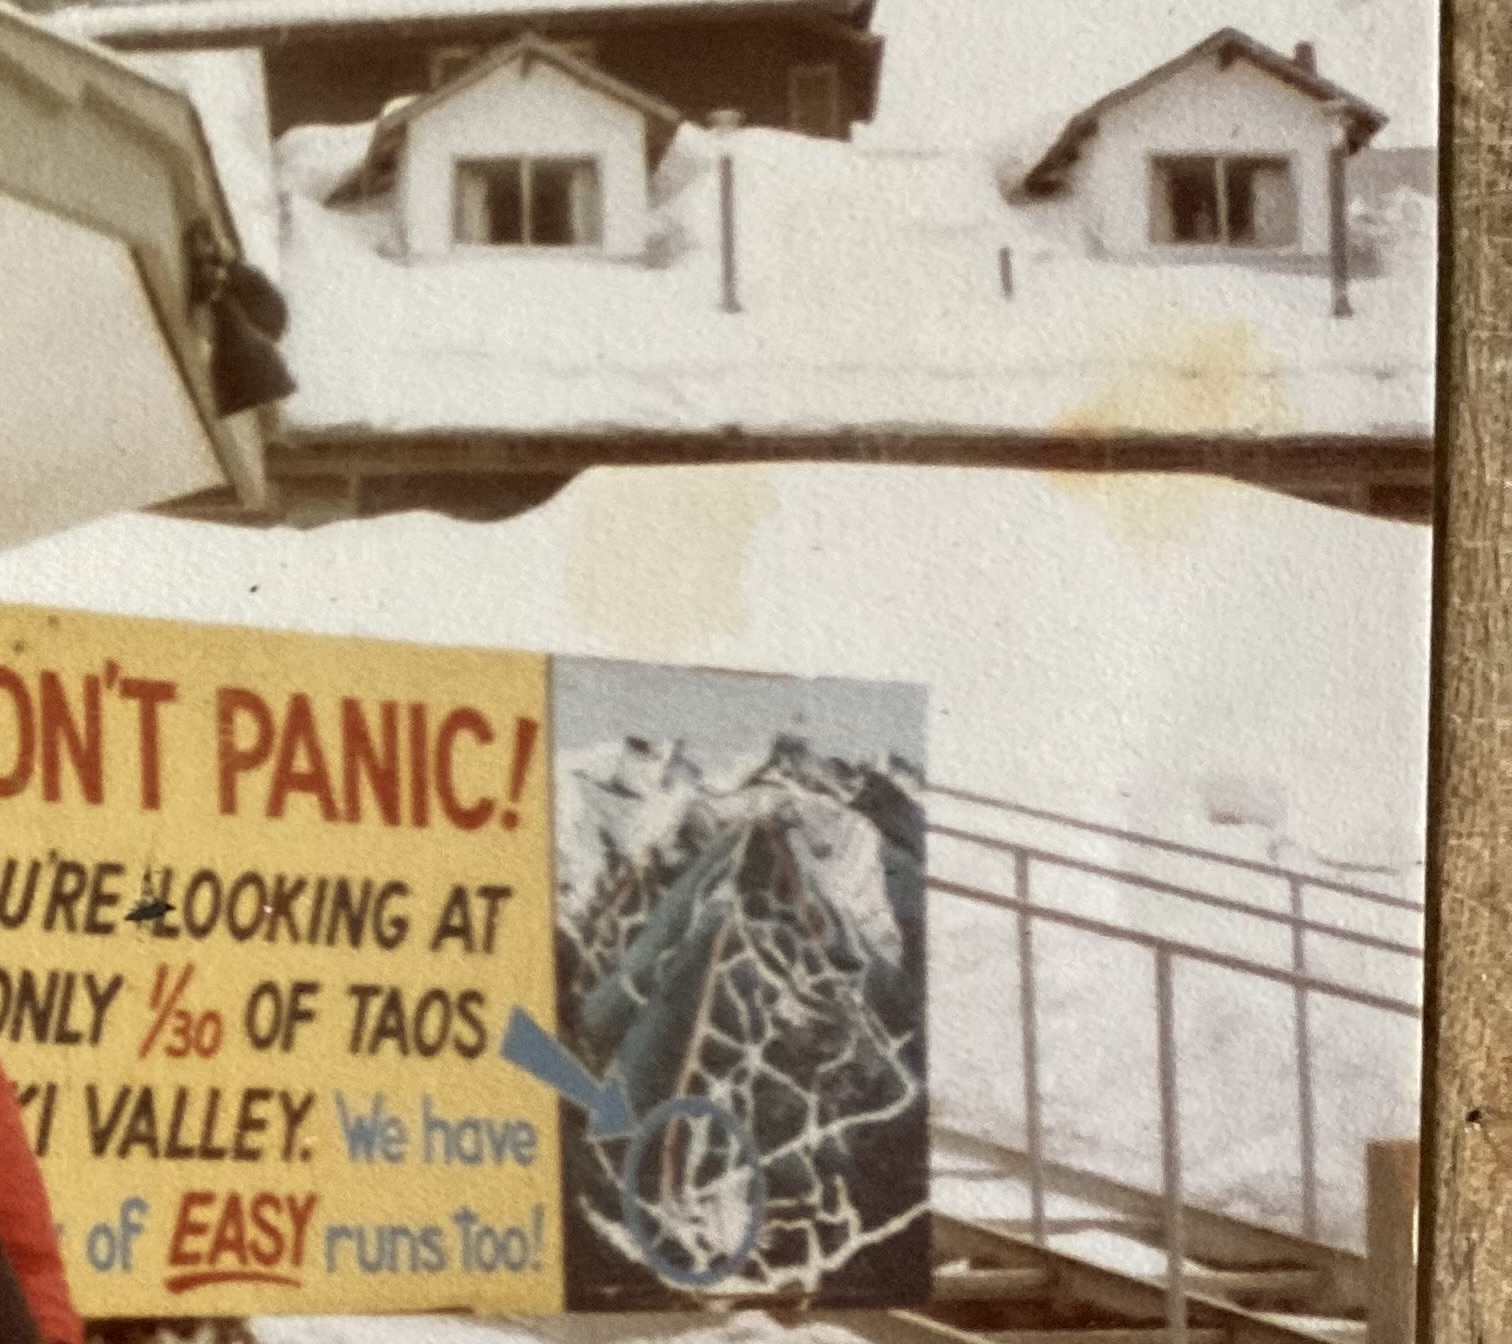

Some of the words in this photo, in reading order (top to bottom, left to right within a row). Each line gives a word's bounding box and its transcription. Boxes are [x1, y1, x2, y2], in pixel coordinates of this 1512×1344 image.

[216, 686, 538, 831] PANIC!
[149, 862, 410, 949] LOOKING
[430, 885, 513, 954] AT
[138, 962, 223, 1059] 1/30
[244, 981, 321, 1052] OF
[347, 984, 488, 1058] TAOS
[85, 1081, 314, 1159] VALLEY.
[336, 1091, 408, 1164] We
[422, 1095, 536, 1167] have
[86, 1194, 150, 1273] of
[166, 1190, 320, 1268] EASY
[324, 1220, 446, 1274] runs
